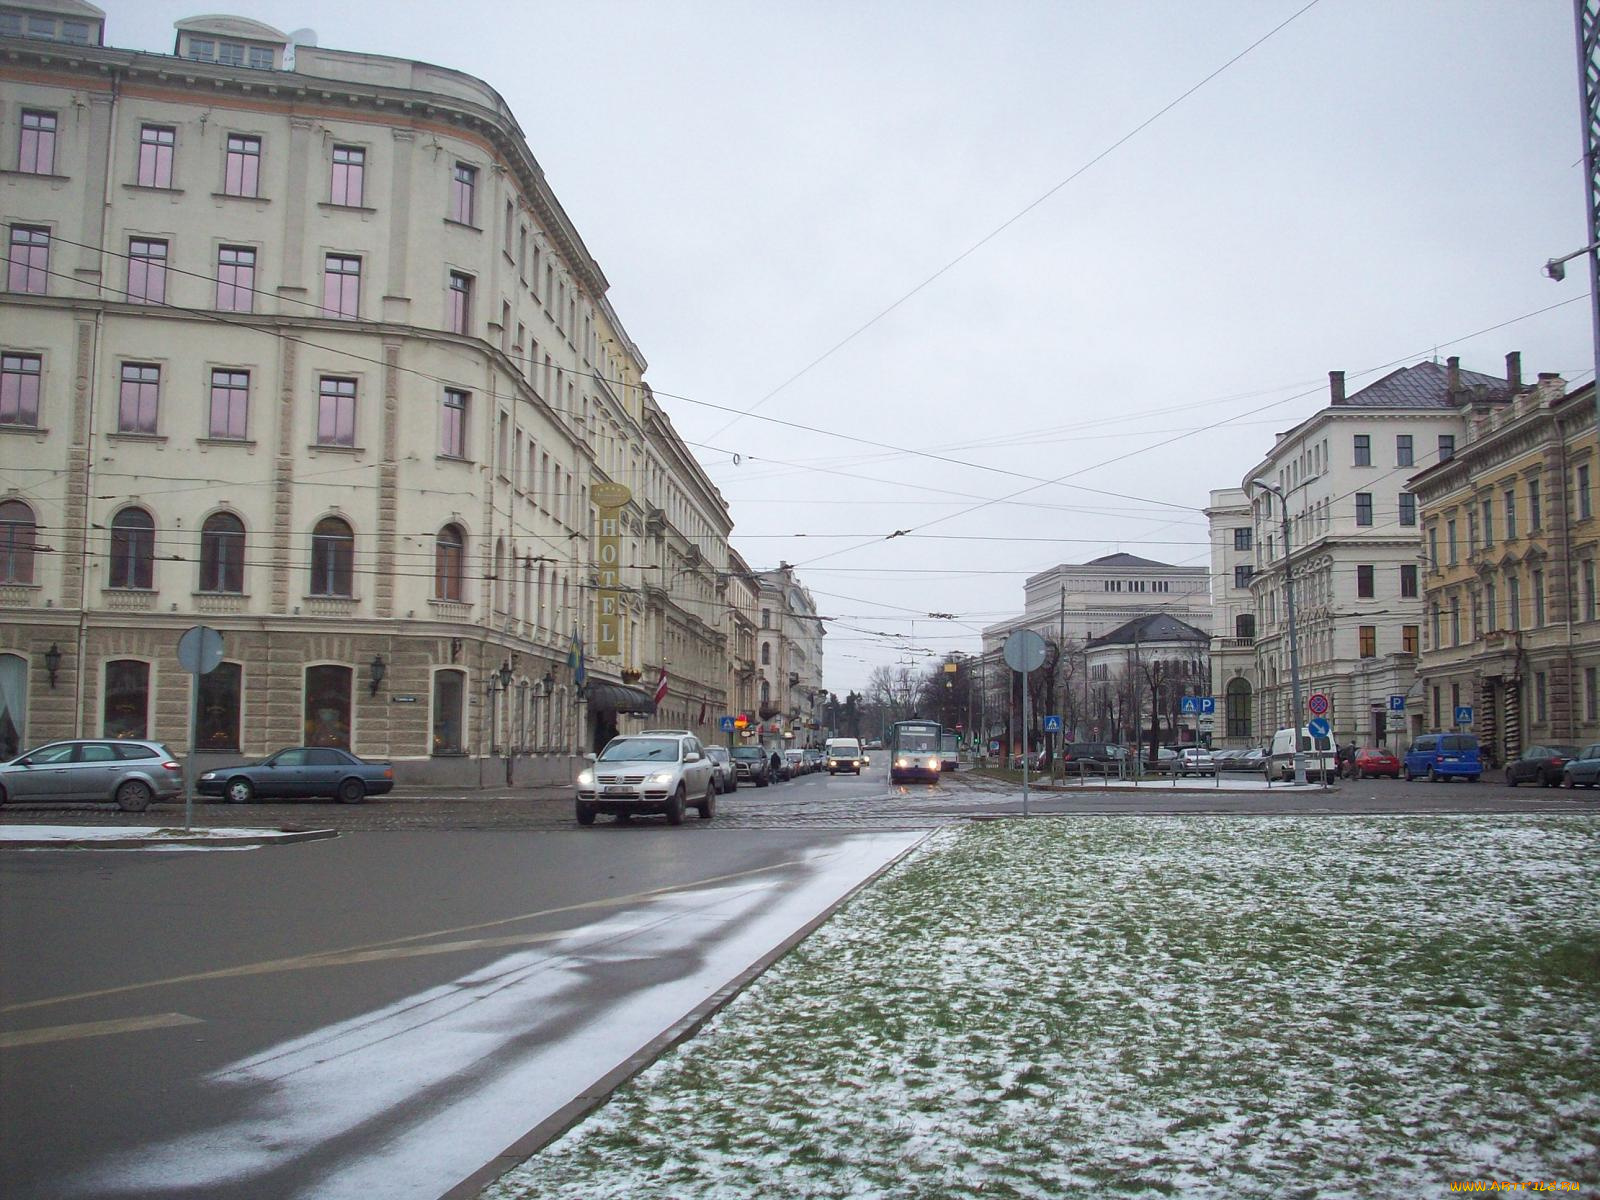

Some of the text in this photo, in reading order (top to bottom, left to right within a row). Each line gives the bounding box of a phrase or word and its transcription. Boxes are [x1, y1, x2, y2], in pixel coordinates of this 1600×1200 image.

[602, 518, 617, 641] HOTEL
[1202, 699, 1212, 712] P
[1393, 697, 1401, 709] P
